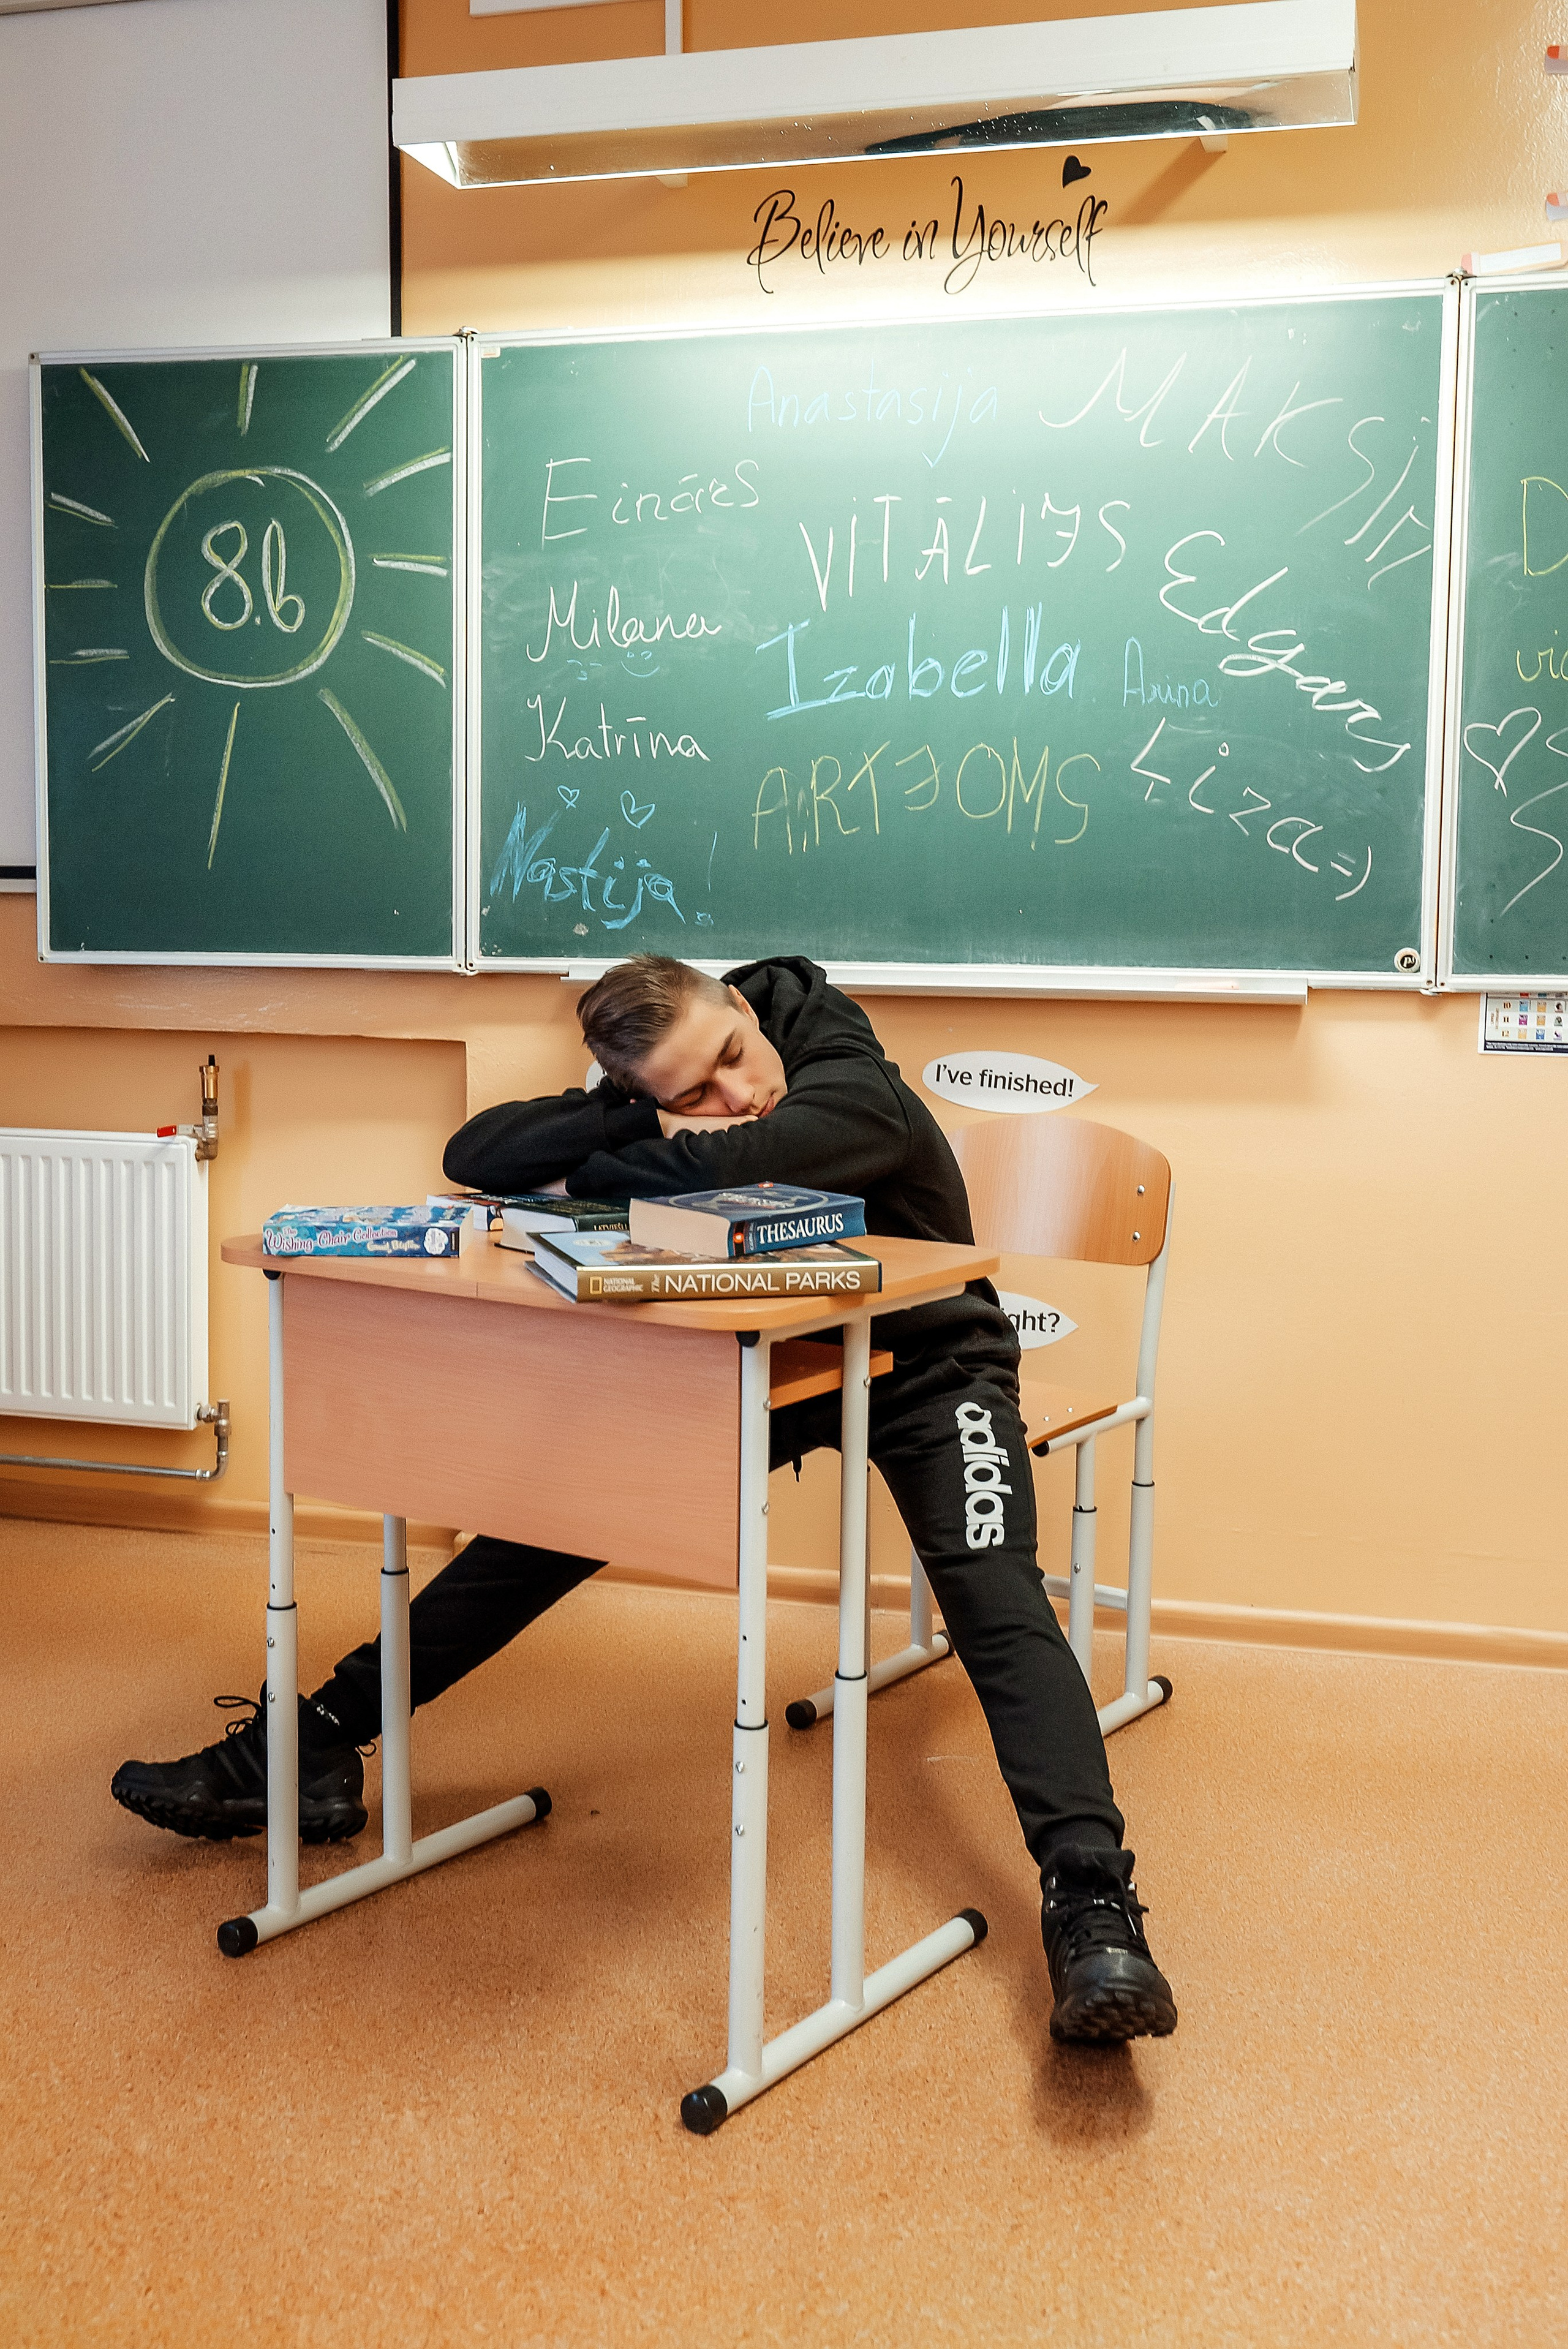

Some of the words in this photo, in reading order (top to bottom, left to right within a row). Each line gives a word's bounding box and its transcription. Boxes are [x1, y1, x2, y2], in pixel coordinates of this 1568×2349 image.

[746, 189, 890, 294] Believe
[902, 218, 938, 260] in
[943, 176, 1109, 295] Yourself
[747, 358, 998, 468] Anastasija
[526, 580, 722, 662] Milana
[755, 602, 1082, 720] Izabella
[524, 694, 710, 761] Katrīna
[935, 1063, 973, 1085] I've
[979, 1069, 1074, 1097] finished!
[266, 1229, 313, 1251] Wishing
[318, 1231, 350, 1247] Chair
[353, 1227, 397, 1240] Collection
[757, 1213, 844, 1244] THESAURUS
[665, 1272, 780, 1293] NATIONAL
[786, 1270, 861, 1291] PARKS
[954, 1401, 1012, 1550] adidas
